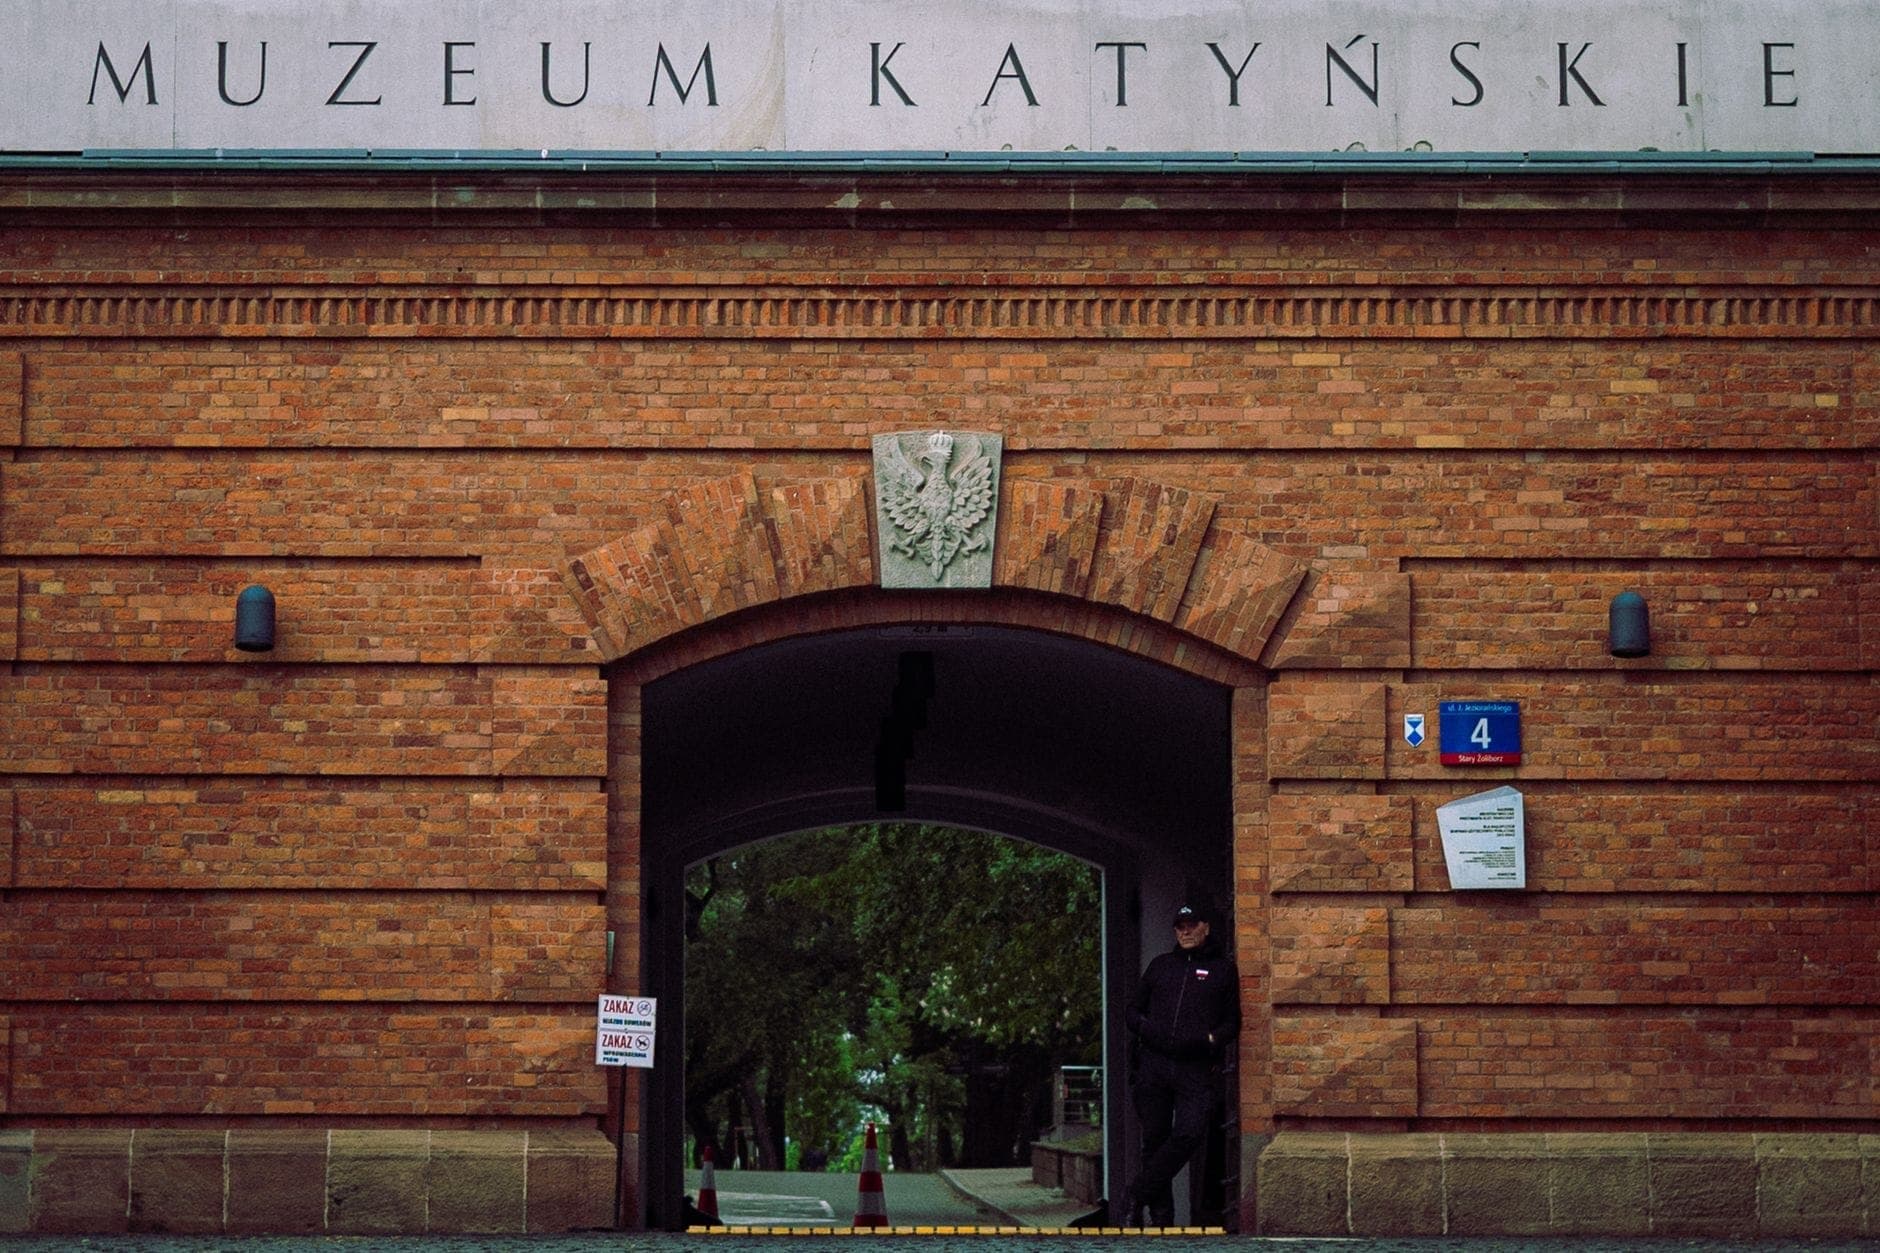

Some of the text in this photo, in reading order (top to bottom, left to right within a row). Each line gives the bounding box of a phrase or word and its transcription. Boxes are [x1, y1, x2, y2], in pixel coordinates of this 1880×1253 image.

[87, 34, 1799, 107] MUZEUM KATYŃSKIE
[1471, 718, 1491, 749] 4
[1458, 754, 1503, 764] Stary Żoliborz
[604, 999, 634, 1014] ZAKAZ
[602, 1034, 633, 1049] ZAKAZ
